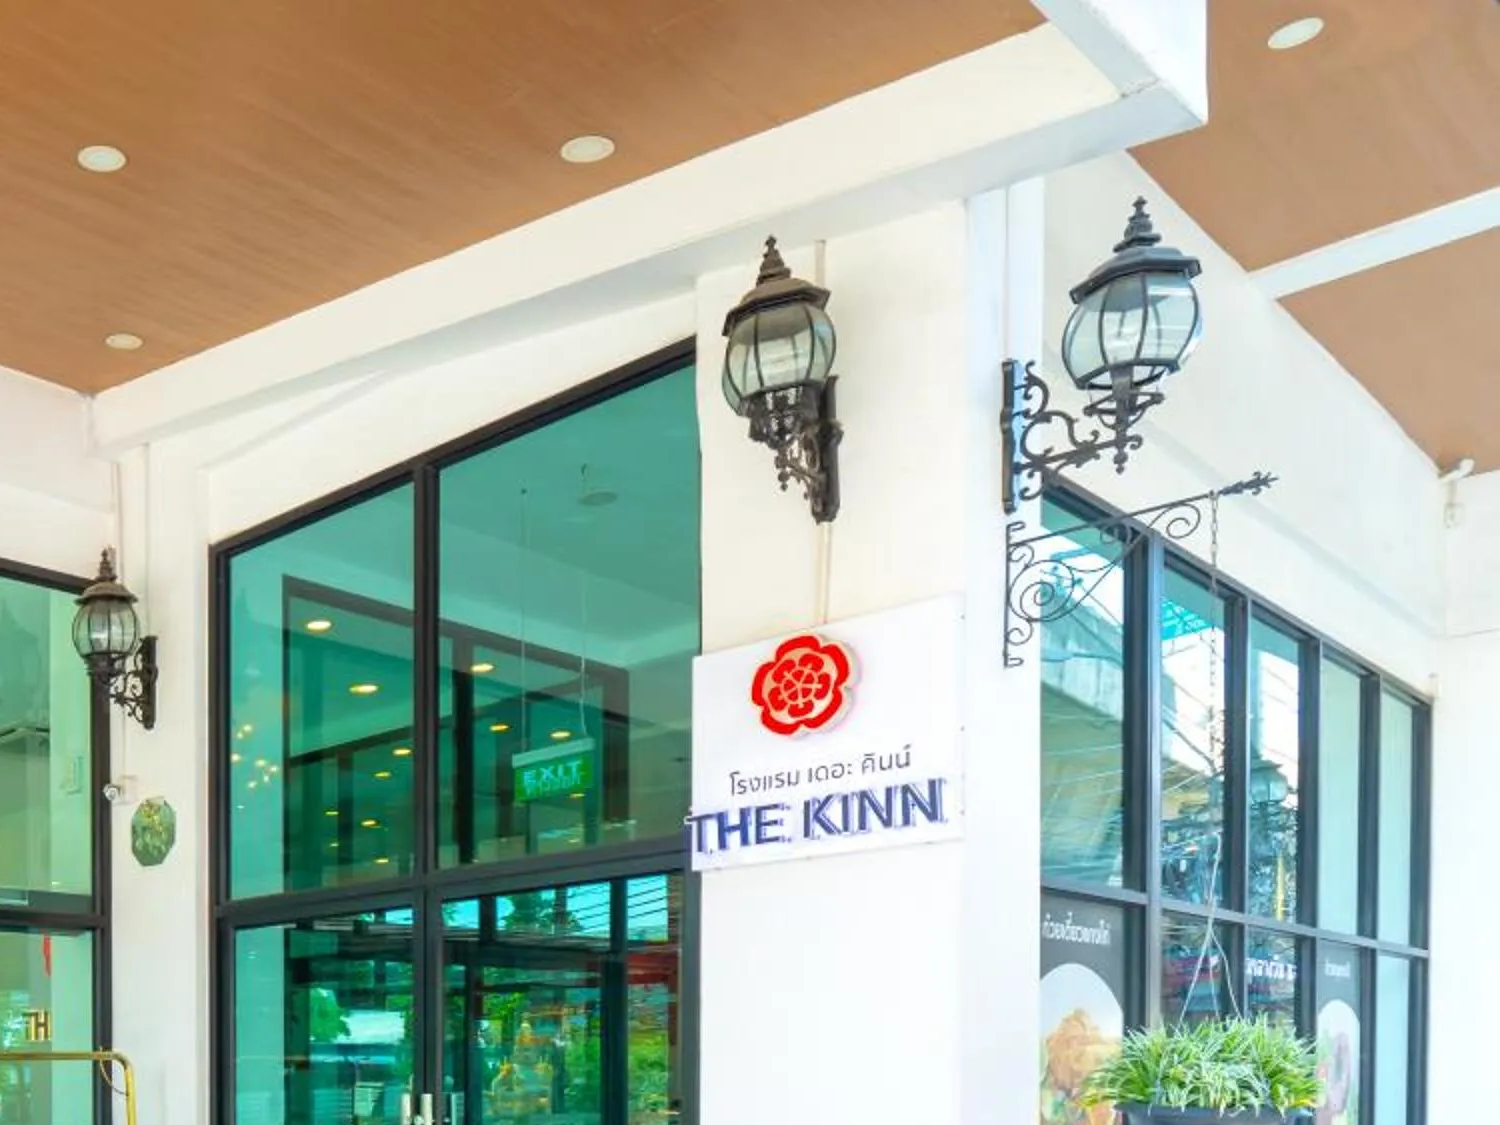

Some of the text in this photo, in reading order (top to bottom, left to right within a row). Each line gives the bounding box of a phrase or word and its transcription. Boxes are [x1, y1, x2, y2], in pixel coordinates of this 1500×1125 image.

[523, 759, 583, 786] EXIT
[729, 743, 911, 796] โรงแรม เดอะ คินน์
[687, 777, 943, 854] THE KINN
